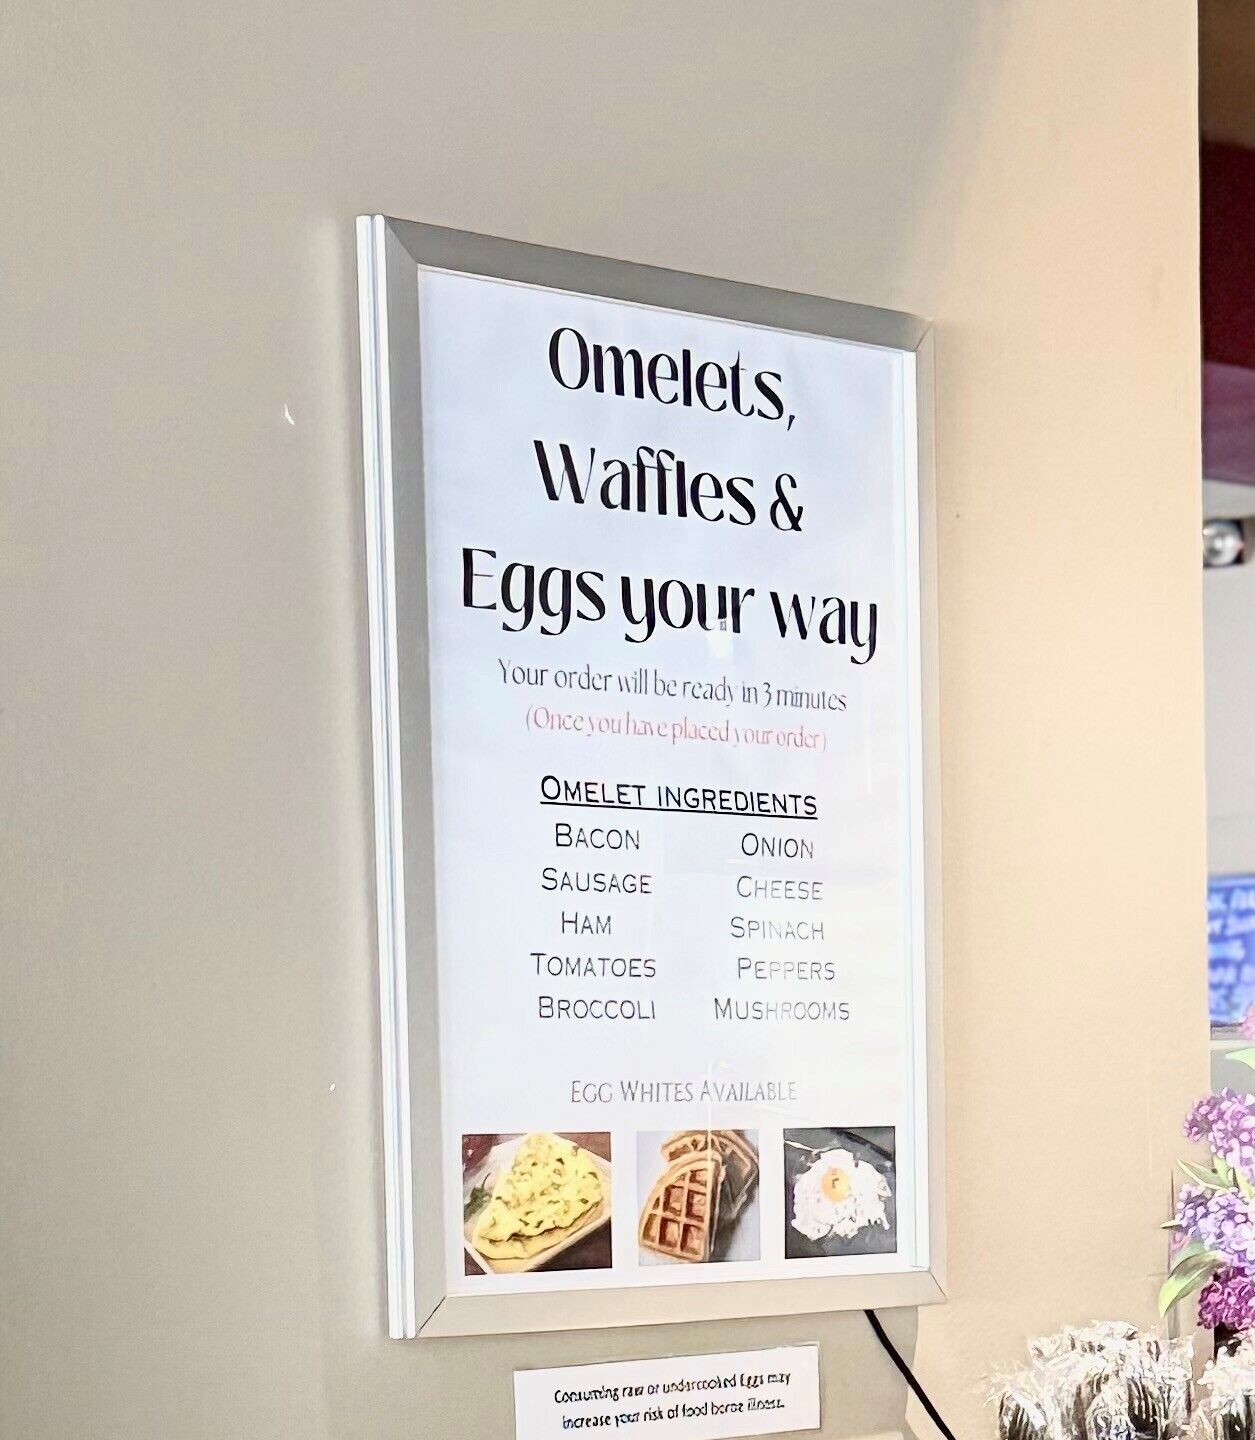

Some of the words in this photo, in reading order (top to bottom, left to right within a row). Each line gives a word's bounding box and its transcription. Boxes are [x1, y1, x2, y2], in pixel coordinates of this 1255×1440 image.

[548, 327, 796, 431] Omelets,
[533, 440, 756, 525] Waffles
[770, 473, 803, 531] &
[463, 548, 605, 635] Eggs
[621, 576, 755, 643] your
[769, 591, 877, 665] way
[498, 658, 549, 686] Your
[554, 664, 613, 692] order
[617, 668, 648, 695] will
[654, 669, 677, 697] be
[683, 676, 733, 708] ready
[742, 681, 758, 704] in
[763, 682, 772, 708] 3
[776, 689, 847, 711] minutes
[526, 704, 584, 731] (Once
[586, 716, 621, 737] you
[626, 710, 668, 737] have
[672, 716, 729, 745] placed
[732, 727, 774, 748] your
[775, 725, 826, 751] order)
[540, 775, 645, 807] OMELET
[656, 786, 818, 816] INGREDIENTS
[555, 823, 639, 850] BACON
[741, 833, 813, 859] ONION
[542, 867, 652, 894] SAUSAGE
[737, 876, 823, 900] CHEESE
[562, 911, 611, 935] HAM
[731, 916, 824, 940] SPINACH
[530, 953, 656, 978] TOMATOES
[737, 957, 835, 981] PEPPERS
[539, 996, 655, 1019] BROCCOLI
[714, 998, 849, 1020] MUSHROOMS
[571, 1080, 612, 1103] EGG
[620, 1080, 693, 1102] WHITES
[701, 1080, 796, 1102] AVAILABLE
[643, 1406, 664, 1421] risk
